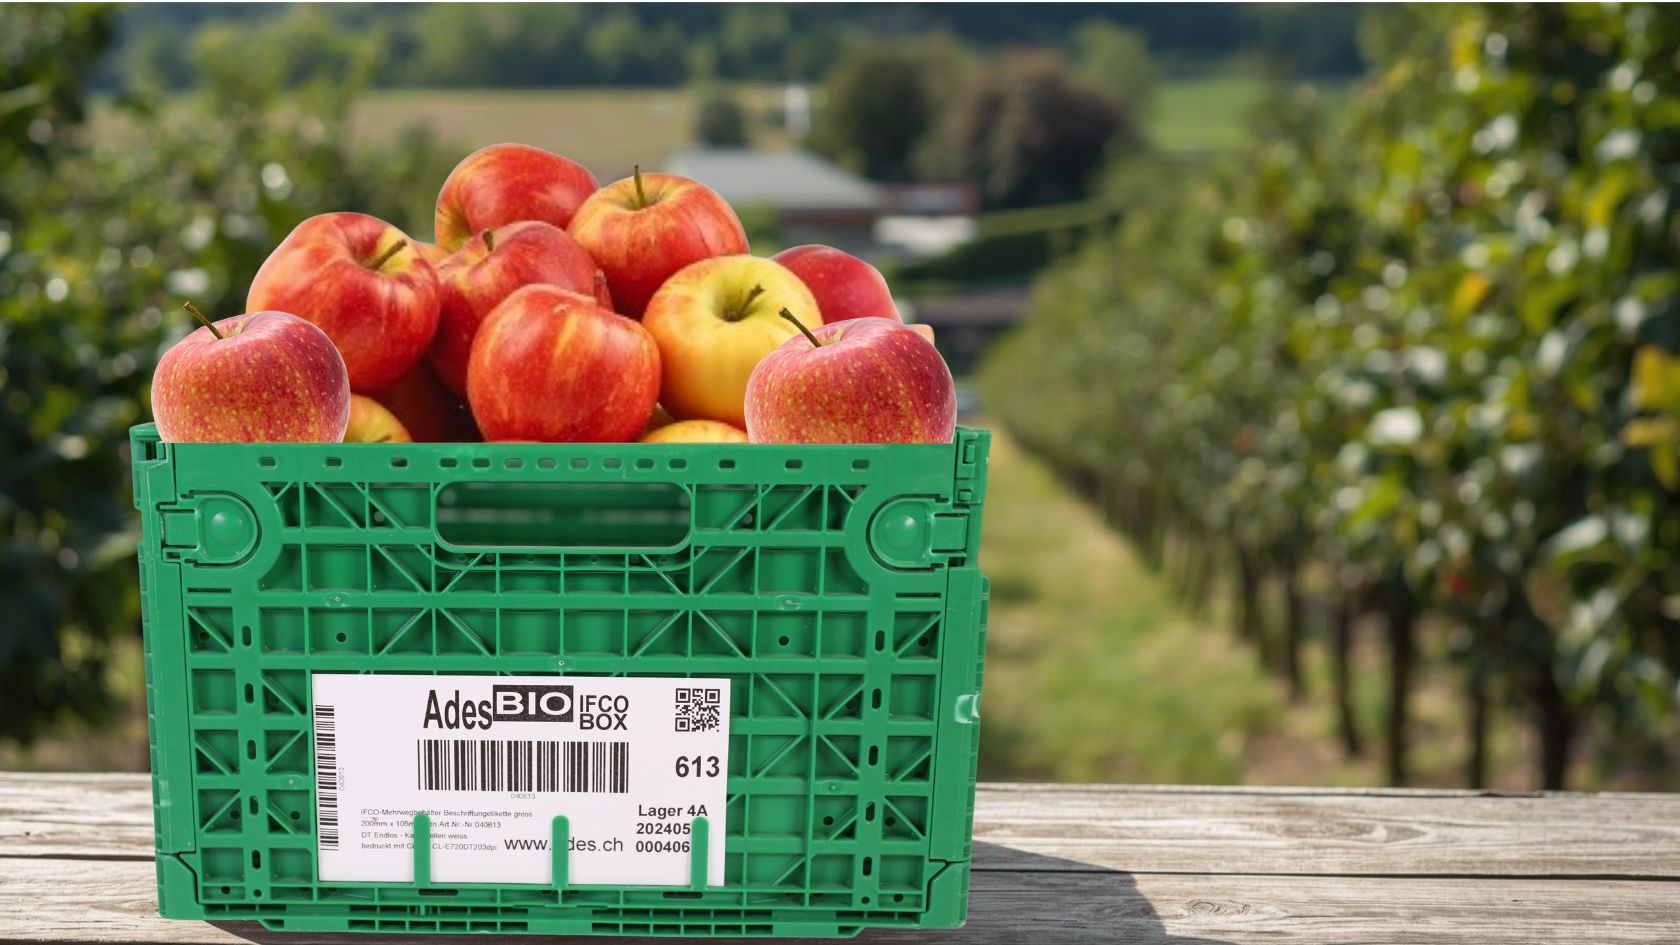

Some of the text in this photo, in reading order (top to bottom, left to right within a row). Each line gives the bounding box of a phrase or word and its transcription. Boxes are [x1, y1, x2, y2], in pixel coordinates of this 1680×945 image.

[496, 691, 572, 716] BIO
[579, 695, 629, 713] IFCO
[579, 713, 628, 730] BOX
[675, 755, 720, 778] 613
[638, 804, 708, 820] Lager 4A
[504, 837, 623, 852] www.des.ch
